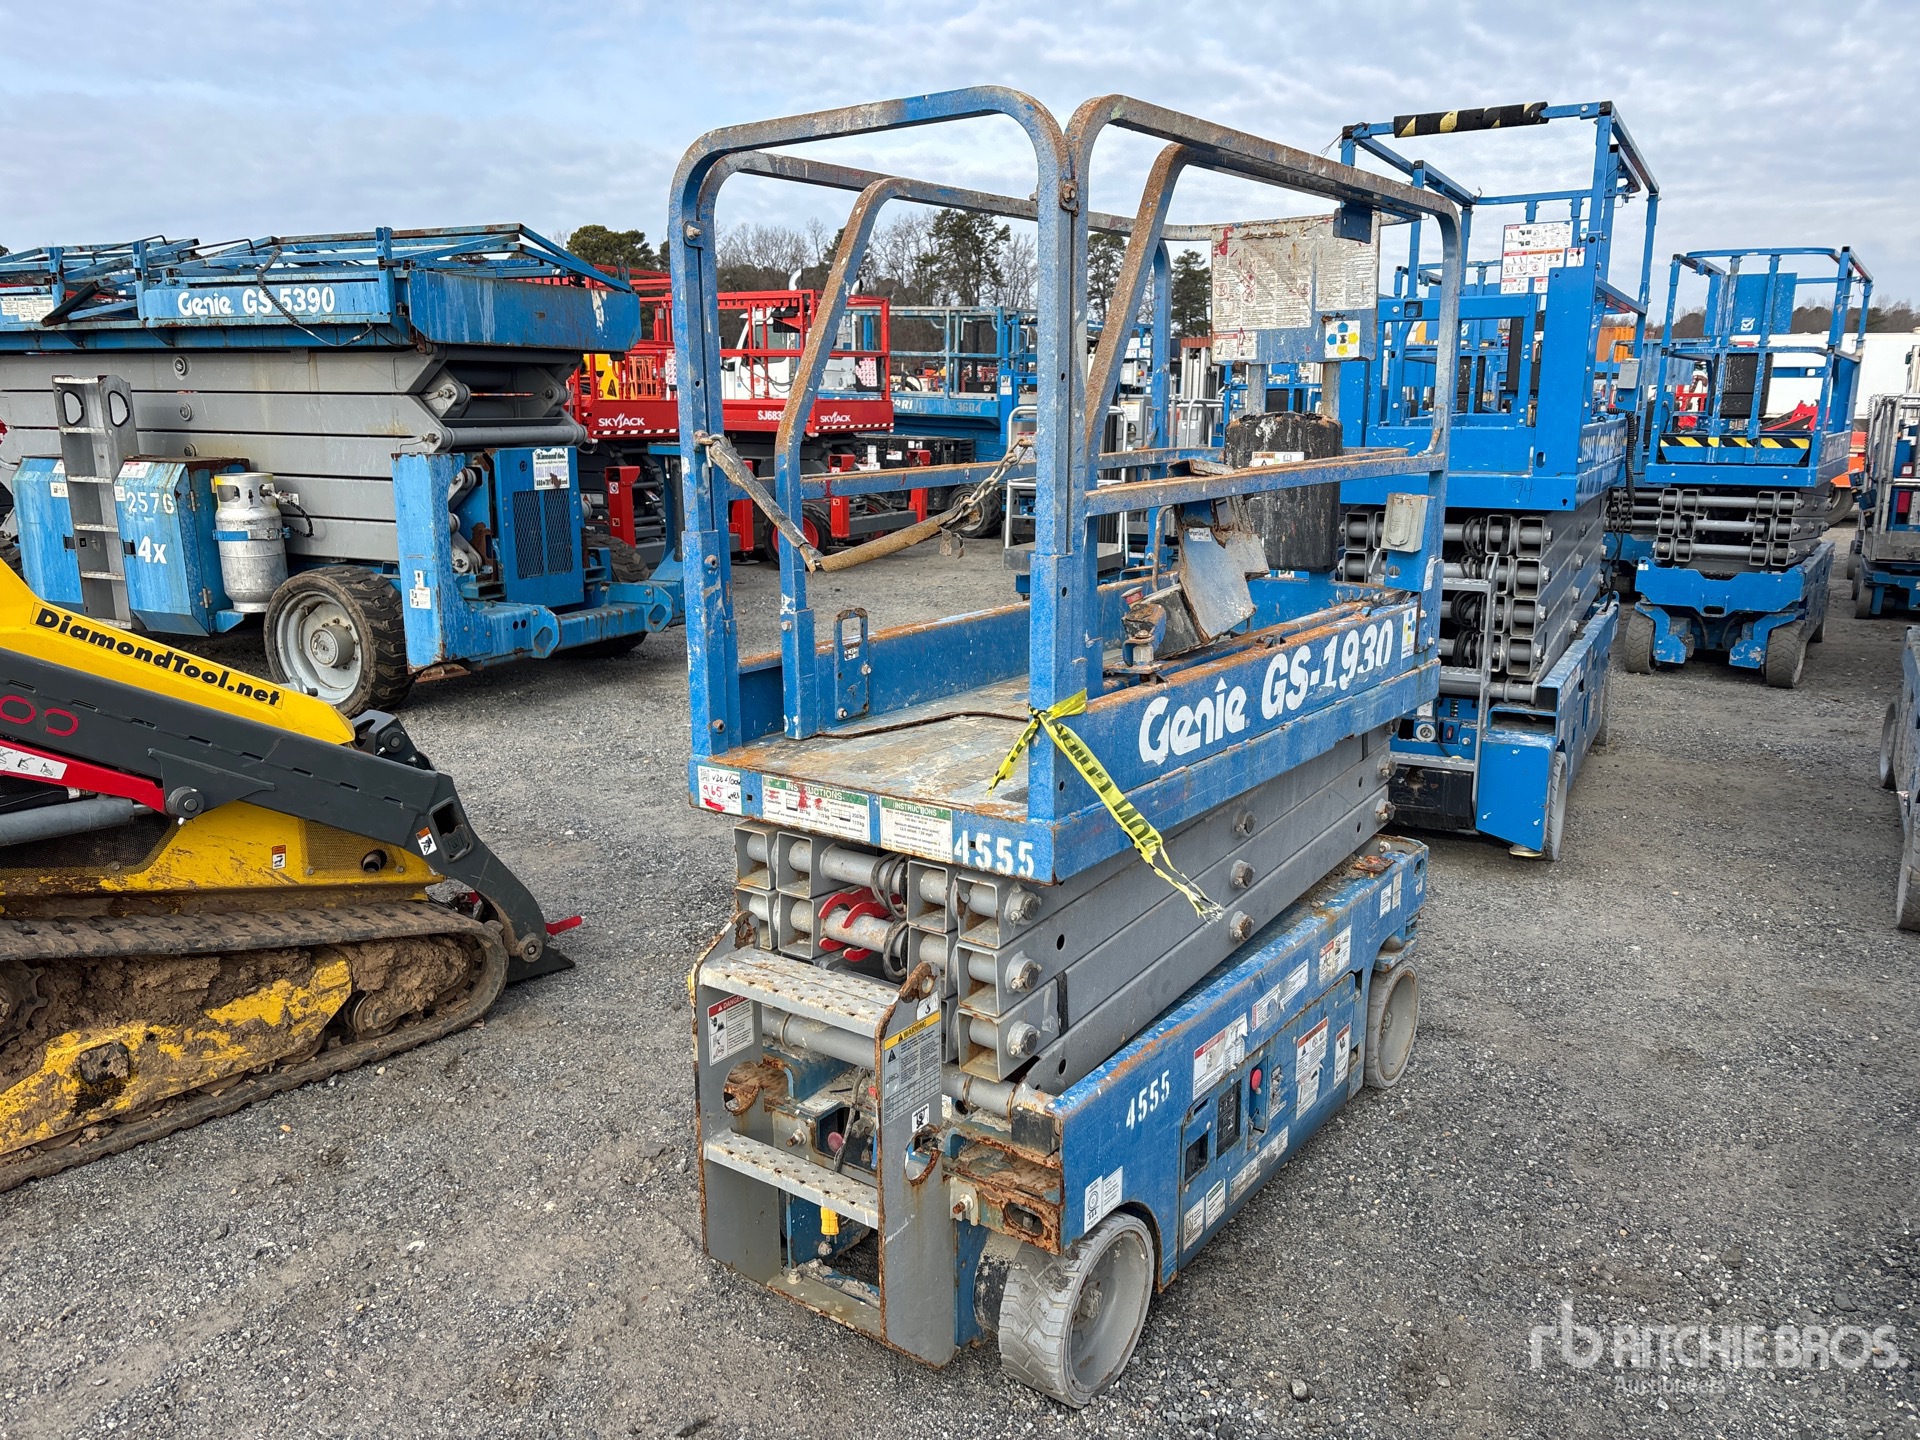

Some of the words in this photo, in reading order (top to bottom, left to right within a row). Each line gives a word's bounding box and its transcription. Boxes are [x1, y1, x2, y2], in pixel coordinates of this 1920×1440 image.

[178, 291, 233, 316] Genie
[242, 288, 273, 314] GS
[279, 286, 335, 313] 5390
[598, 413, 646, 429] SKYJACK
[819, 411, 852, 425] SKYJACK
[126, 491, 175, 515] 2576
[137, 535, 168, 565] 4x
[35, 608, 280, 706] DiamondTool.net
[1138, 676, 1247, 766] Genie
[1261, 619, 1393, 720] GS-1930
[785, 782, 843, 801] INSUCTIONS
[893, 799, 937, 817] INSTRUCTIONS
[954, 831, 1035, 879] 4555
[1125, 1069, 1170, 1130] 4555
